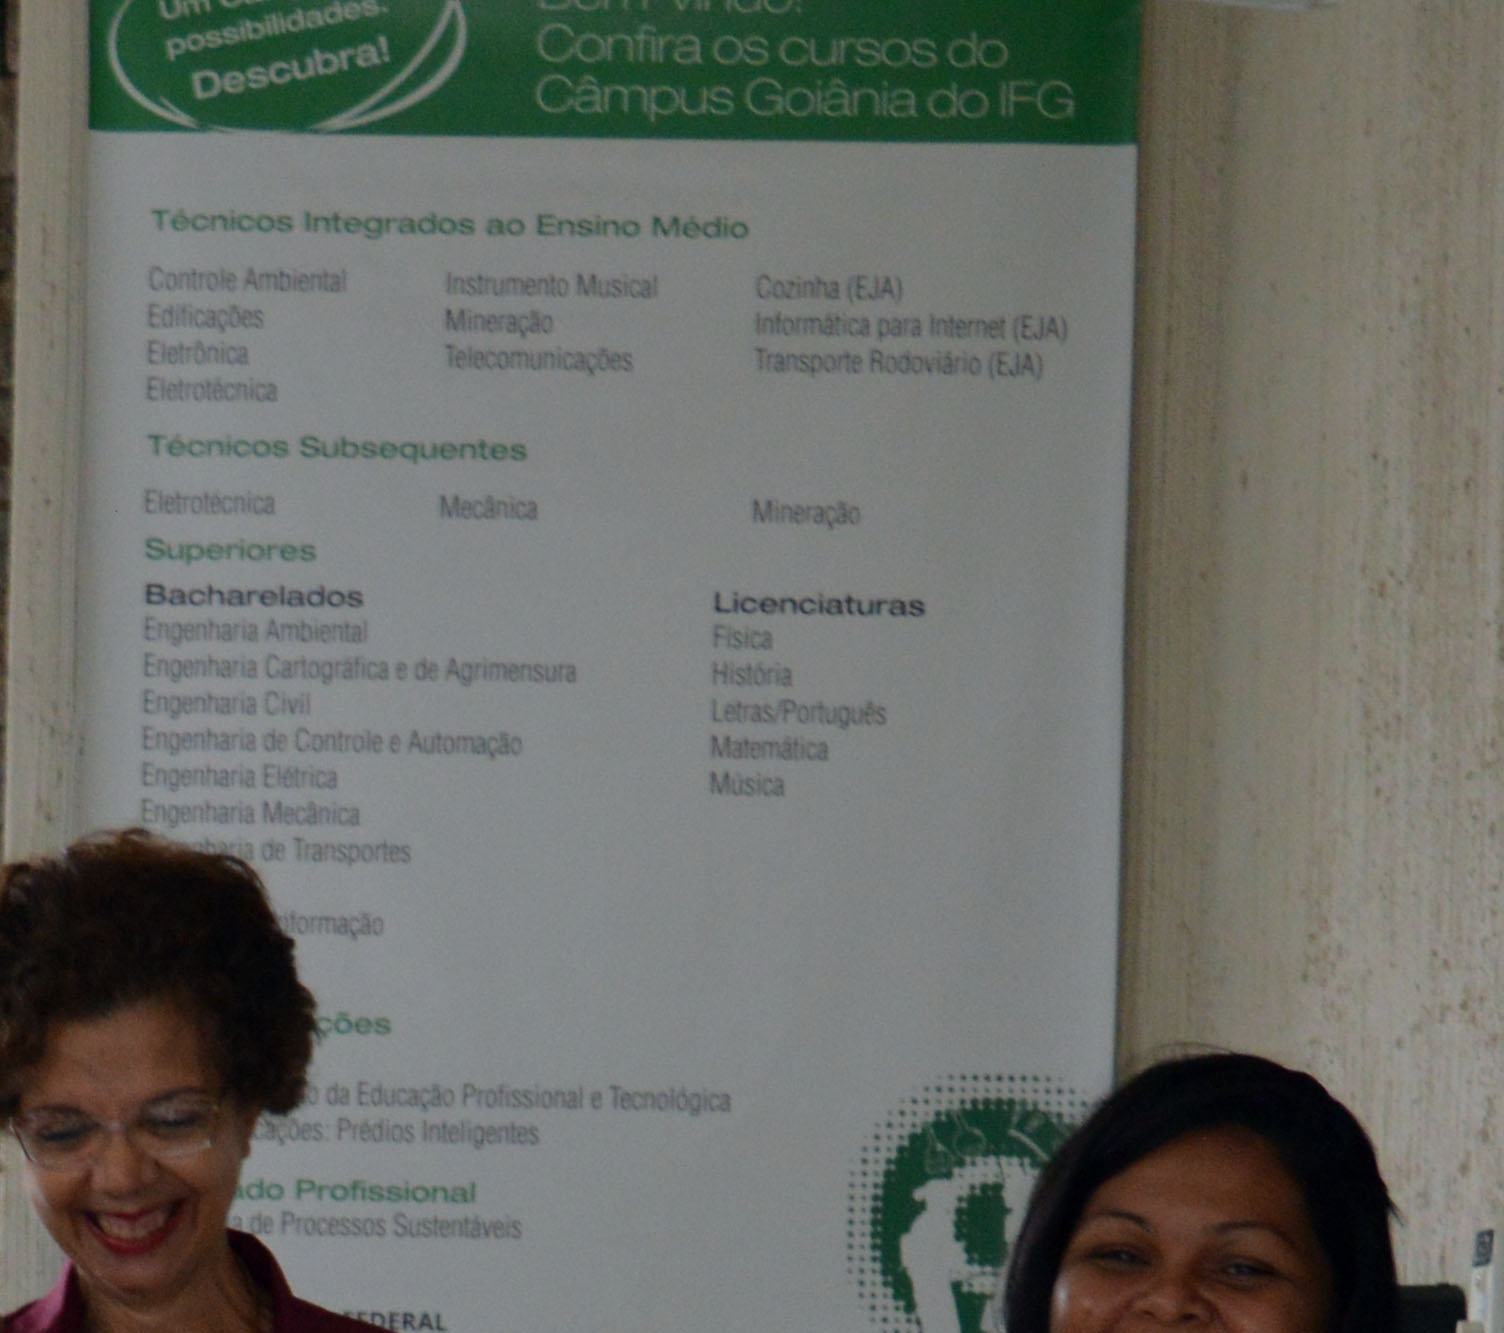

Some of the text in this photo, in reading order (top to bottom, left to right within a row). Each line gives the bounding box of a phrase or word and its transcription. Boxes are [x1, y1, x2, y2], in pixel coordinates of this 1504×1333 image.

[165, 0, 390, 61] possibilidades.
[535, 23, 1010, 70] Confira os cursos do
[191, 34, 391, 100] Descubra!
[535, 73, 1075, 122] Câmpus Goiânia do IFG
[150, 208, 750, 240] Técnicos Integrados ao Ensino Médio
[147, 266, 348, 294] Controle Ambiental
[445, 271, 659, 300] Instrumento Musical
[754, 274, 904, 304] Cozinha (EJA)
[146, 303, 265, 333] Edificações
[444, 308, 554, 339] Mineração
[754, 311, 1069, 344] Informática para Internet (EJA)
[146, 339, 250, 366] Eletrônica
[445, 343, 634, 376] Telecomunicações
[754, 347, 1044, 380] Transporte Rodoviário (EJA)
[146, 376, 279, 403] Eletrotécnica
[147, 433, 529, 465] Técnicos Subsequentes
[143, 488, 277, 516] Eletrotécnica
[439, 493, 539, 521] Mecânica
[751, 499, 861, 530] Mineração
[144, 537, 318, 566] Superiores
[144, 583, 365, 608] Bacharelados
[713, 590, 927, 618] Licenciaturas
[142, 616, 369, 646] Engenharia Ambiental
[712, 624, 774, 652] Física
[142, 653, 578, 687] Engenharia Cartográfica e de Agrimensura
[711, 661, 794, 688] História
[141, 690, 312, 719] Engenharia Civil
[710, 699, 888, 731] Letras/Português
[141, 726, 524, 761] Engenharia de Controle e Automação
[709, 735, 830, 763] Matemática
[141, 763, 339, 792] Engenharia Elétrica
[708, 771, 786, 798] Música
[141, 799, 362, 829] Engenharia Mecânica
[261, 837, 287, 862] de
[292, 838, 413, 866] Transportes
[277, 910, 385, 942] nformação
[325, 1082, 351, 1108] da
[356, 1082, 456, 1113] Educação
[462, 1083, 585, 1111] Profissional
[589, 1091, 603, 1110] e
[608, 1085, 733, 1117] Tecnológica
[252, 1118, 541, 1151] cações: Prédios Inteligentes
[295, 1179, 478, 1204] Profissional
[250, 1211, 273, 1236] de
[281, 1213, 387, 1238] Processos
[393, 1213, 523, 1240] Sustentáveis
